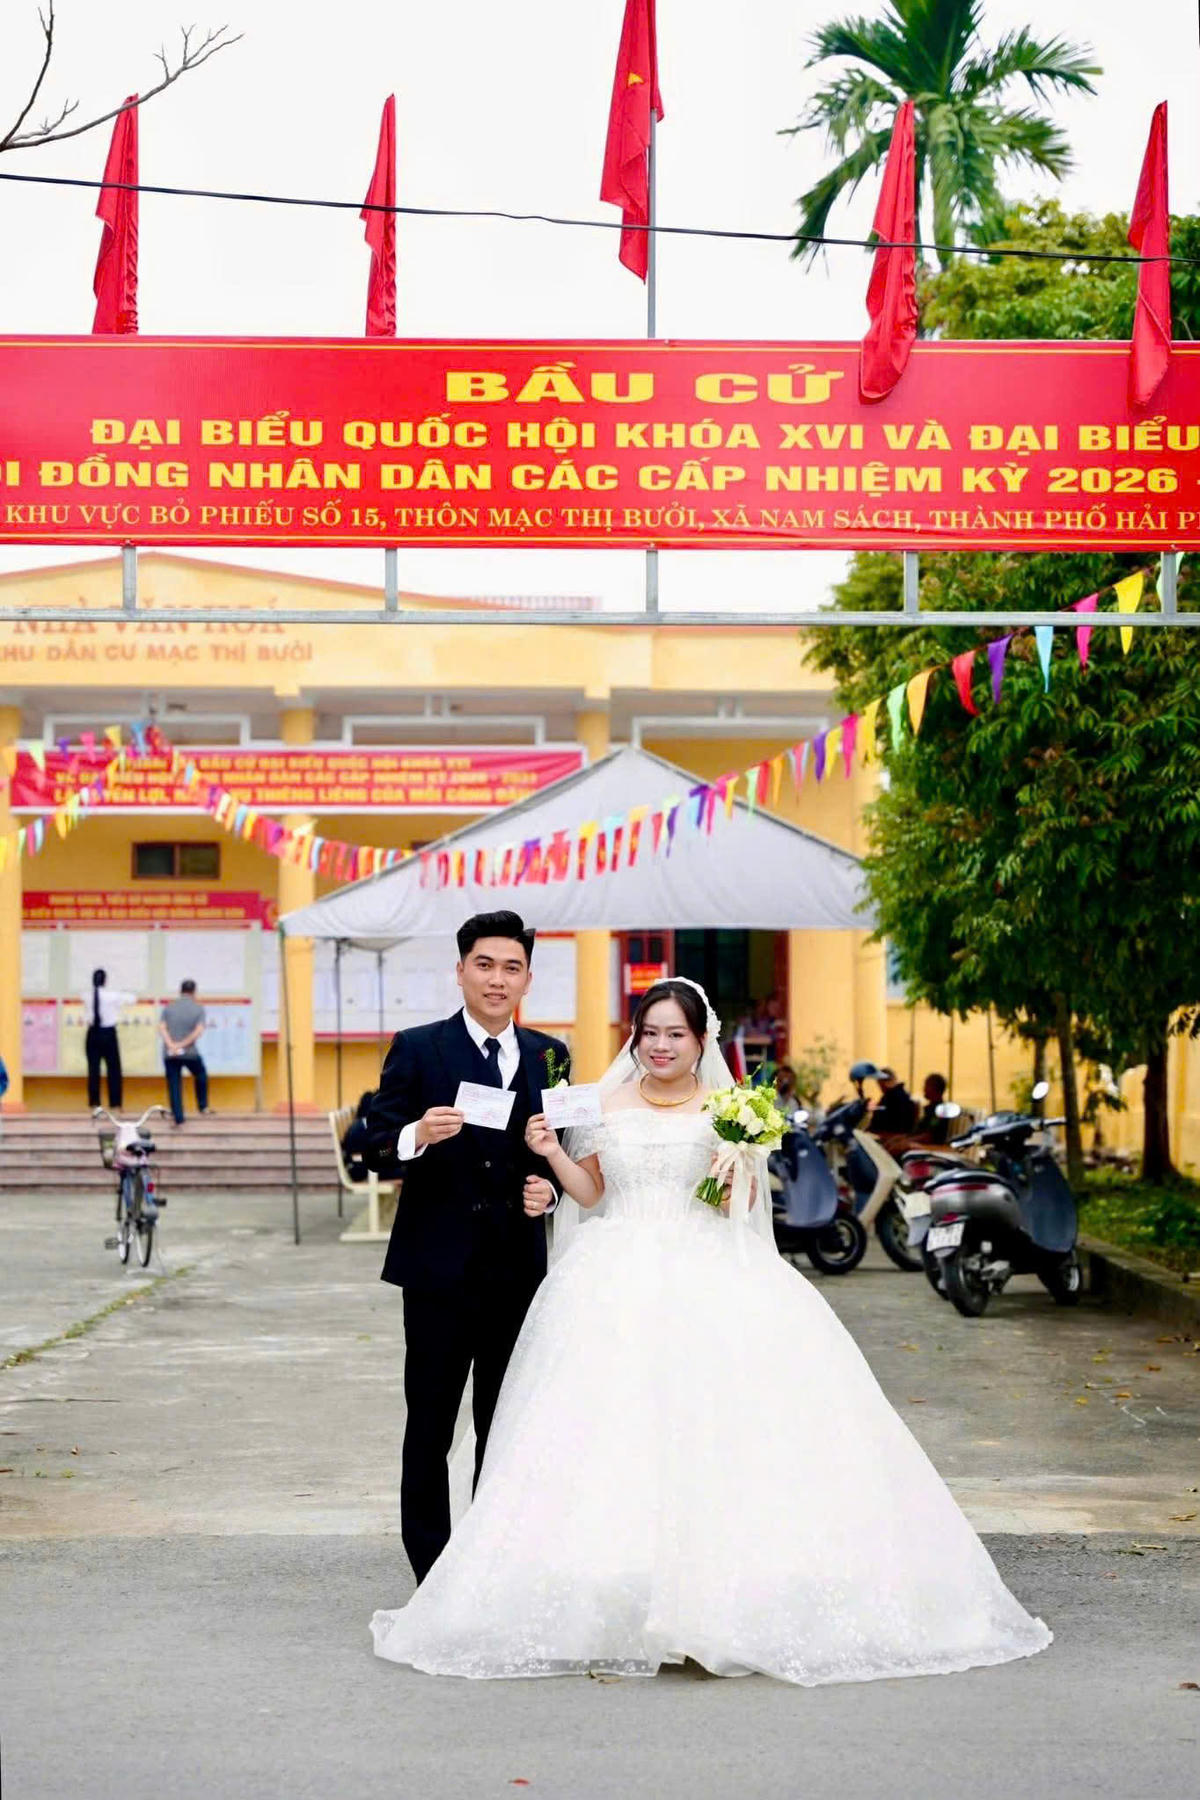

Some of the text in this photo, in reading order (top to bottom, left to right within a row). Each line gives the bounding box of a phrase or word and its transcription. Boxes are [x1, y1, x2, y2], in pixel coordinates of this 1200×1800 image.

[446, 361, 845, 405] BẦU CỬ
[91, 410, 1200, 456] ĐẠI BIỂU QUỐC HỘI KHÓA XVI VÀ ĐẠI BIỂU
[38, 452, 189, 488] ĐỒNG
[209, 458, 361, 489] NHÂN
[381, 459, 491, 490] DÂN
[512, 458, 619, 490] CÁC
[638, 456, 746, 491] CẤP
[766, 461, 942, 497] NHIỆM
[963, 462, 1029, 493] KỲ
[1048, 467, 1178, 493] 2026
[6, 497, 1200, 533] KHU VỰC BỎ PHIẾU SỐ 15, THÔN MẠC THỊ BƯỞI, XÃ NAM SÁCH, THÀNH PHỐ HẢI P
